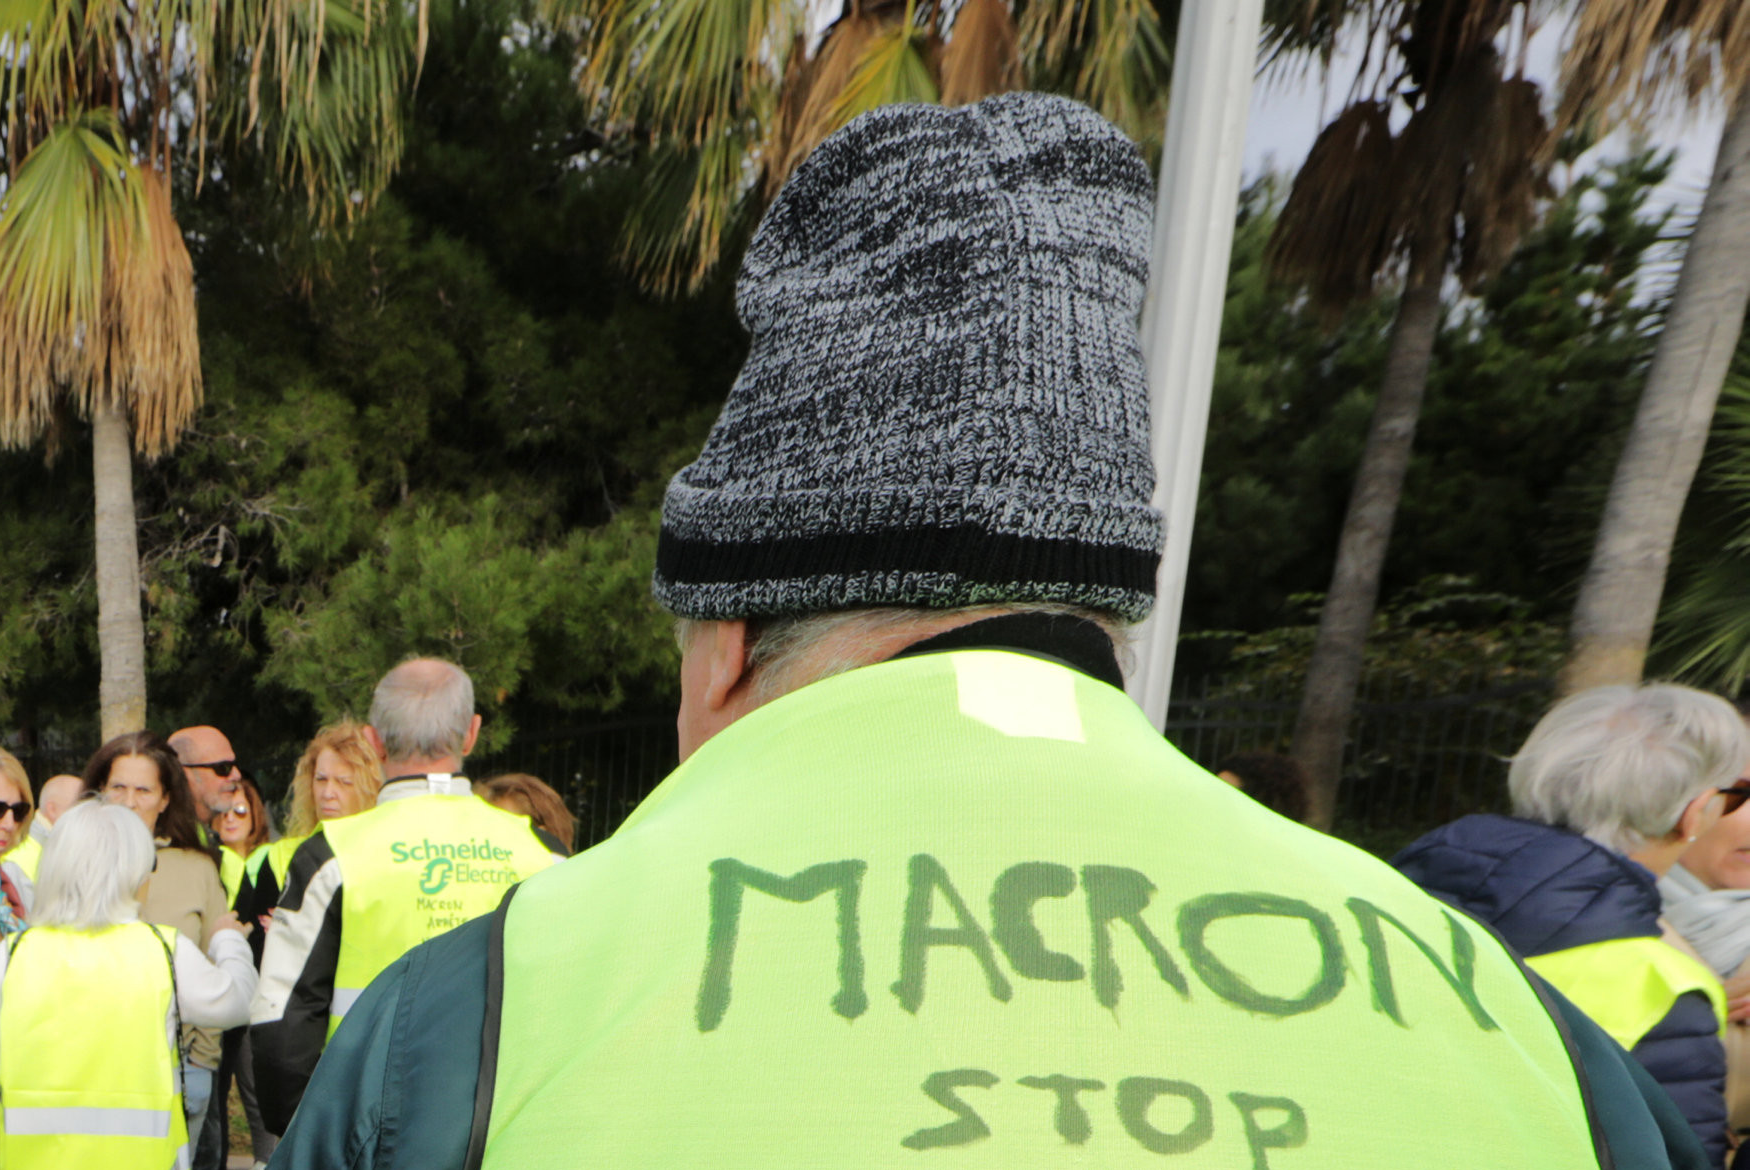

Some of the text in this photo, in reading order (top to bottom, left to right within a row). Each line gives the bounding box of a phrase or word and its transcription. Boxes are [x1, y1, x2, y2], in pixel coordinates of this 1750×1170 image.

[391, 838, 513, 863] Schneider
[456, 863, 520, 884] Electric
[696, 853, 1502, 1033] MACRON
